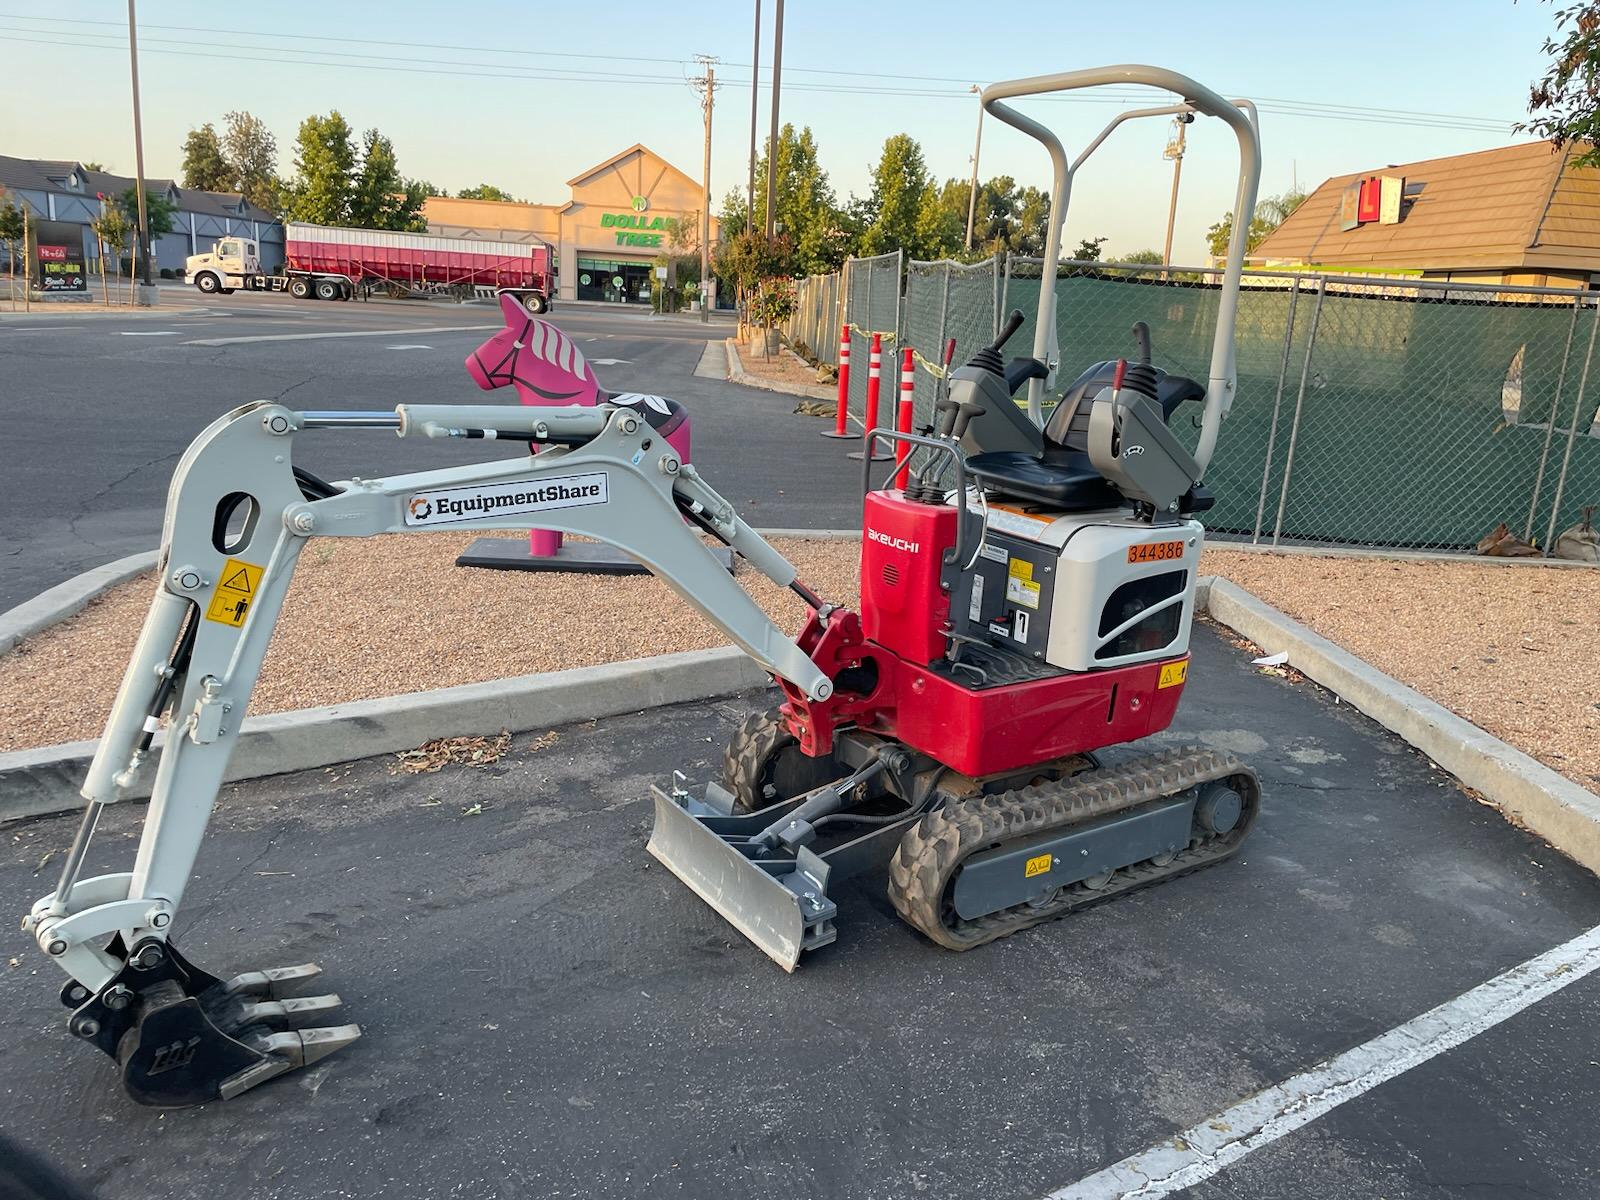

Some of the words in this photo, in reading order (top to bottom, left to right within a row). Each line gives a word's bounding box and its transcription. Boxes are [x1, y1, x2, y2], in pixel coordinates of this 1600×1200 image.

[616, 232, 664, 248] TREE
[436, 484, 600, 516] EquipmentShare
[1129, 541, 1183, 563] 344386
